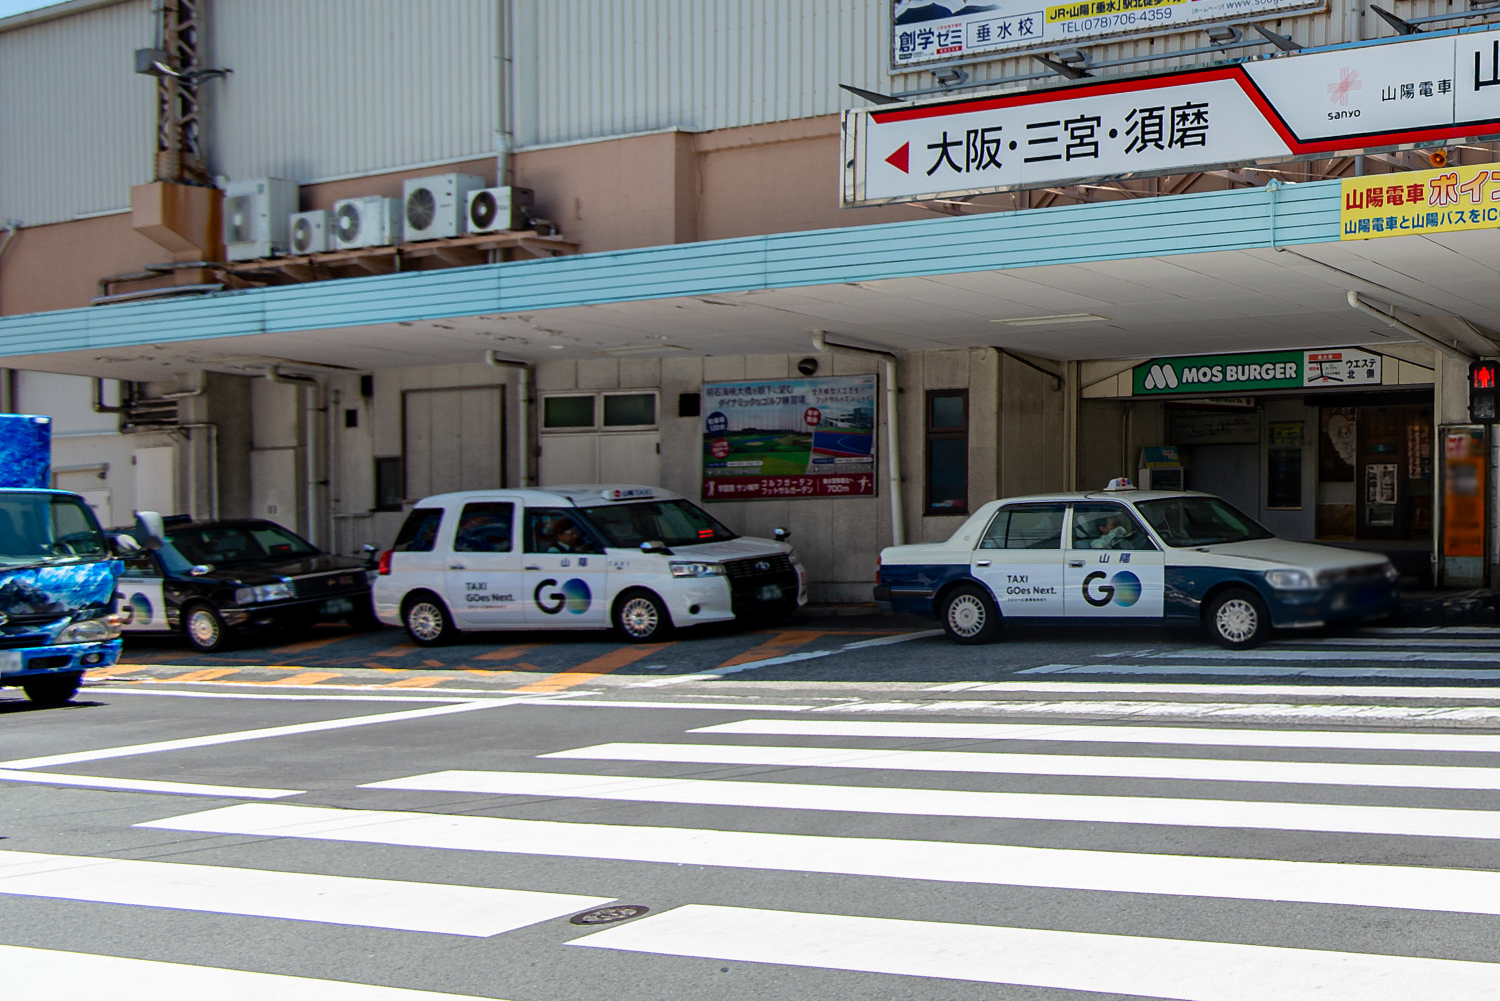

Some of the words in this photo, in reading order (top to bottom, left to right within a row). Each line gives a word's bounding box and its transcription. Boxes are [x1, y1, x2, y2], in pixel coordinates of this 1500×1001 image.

[976, 17, 1034, 43] 垂水校
[1381, 79, 1453, 101] 山陽電車
[1327, 109, 1361, 121] sanyo
[926, 101, 1210, 176] 大阪・三宮・須磨
[1345, 359, 1376, 369] ウエステ
[1181, 366, 1223, 384] MOS
[1226, 362, 1297, 382] BURGER
[760, 478, 814, 487] ゴルフガーデン
[760, 486, 814, 495] フットサルガーデン
[826, 484, 850, 493] 700m
[1006, 575, 1029, 583] TAXI
[465, 582, 488, 591] TAXI
[1006, 586, 1031, 595] GOes
[1032, 586, 1057, 595] Next.
